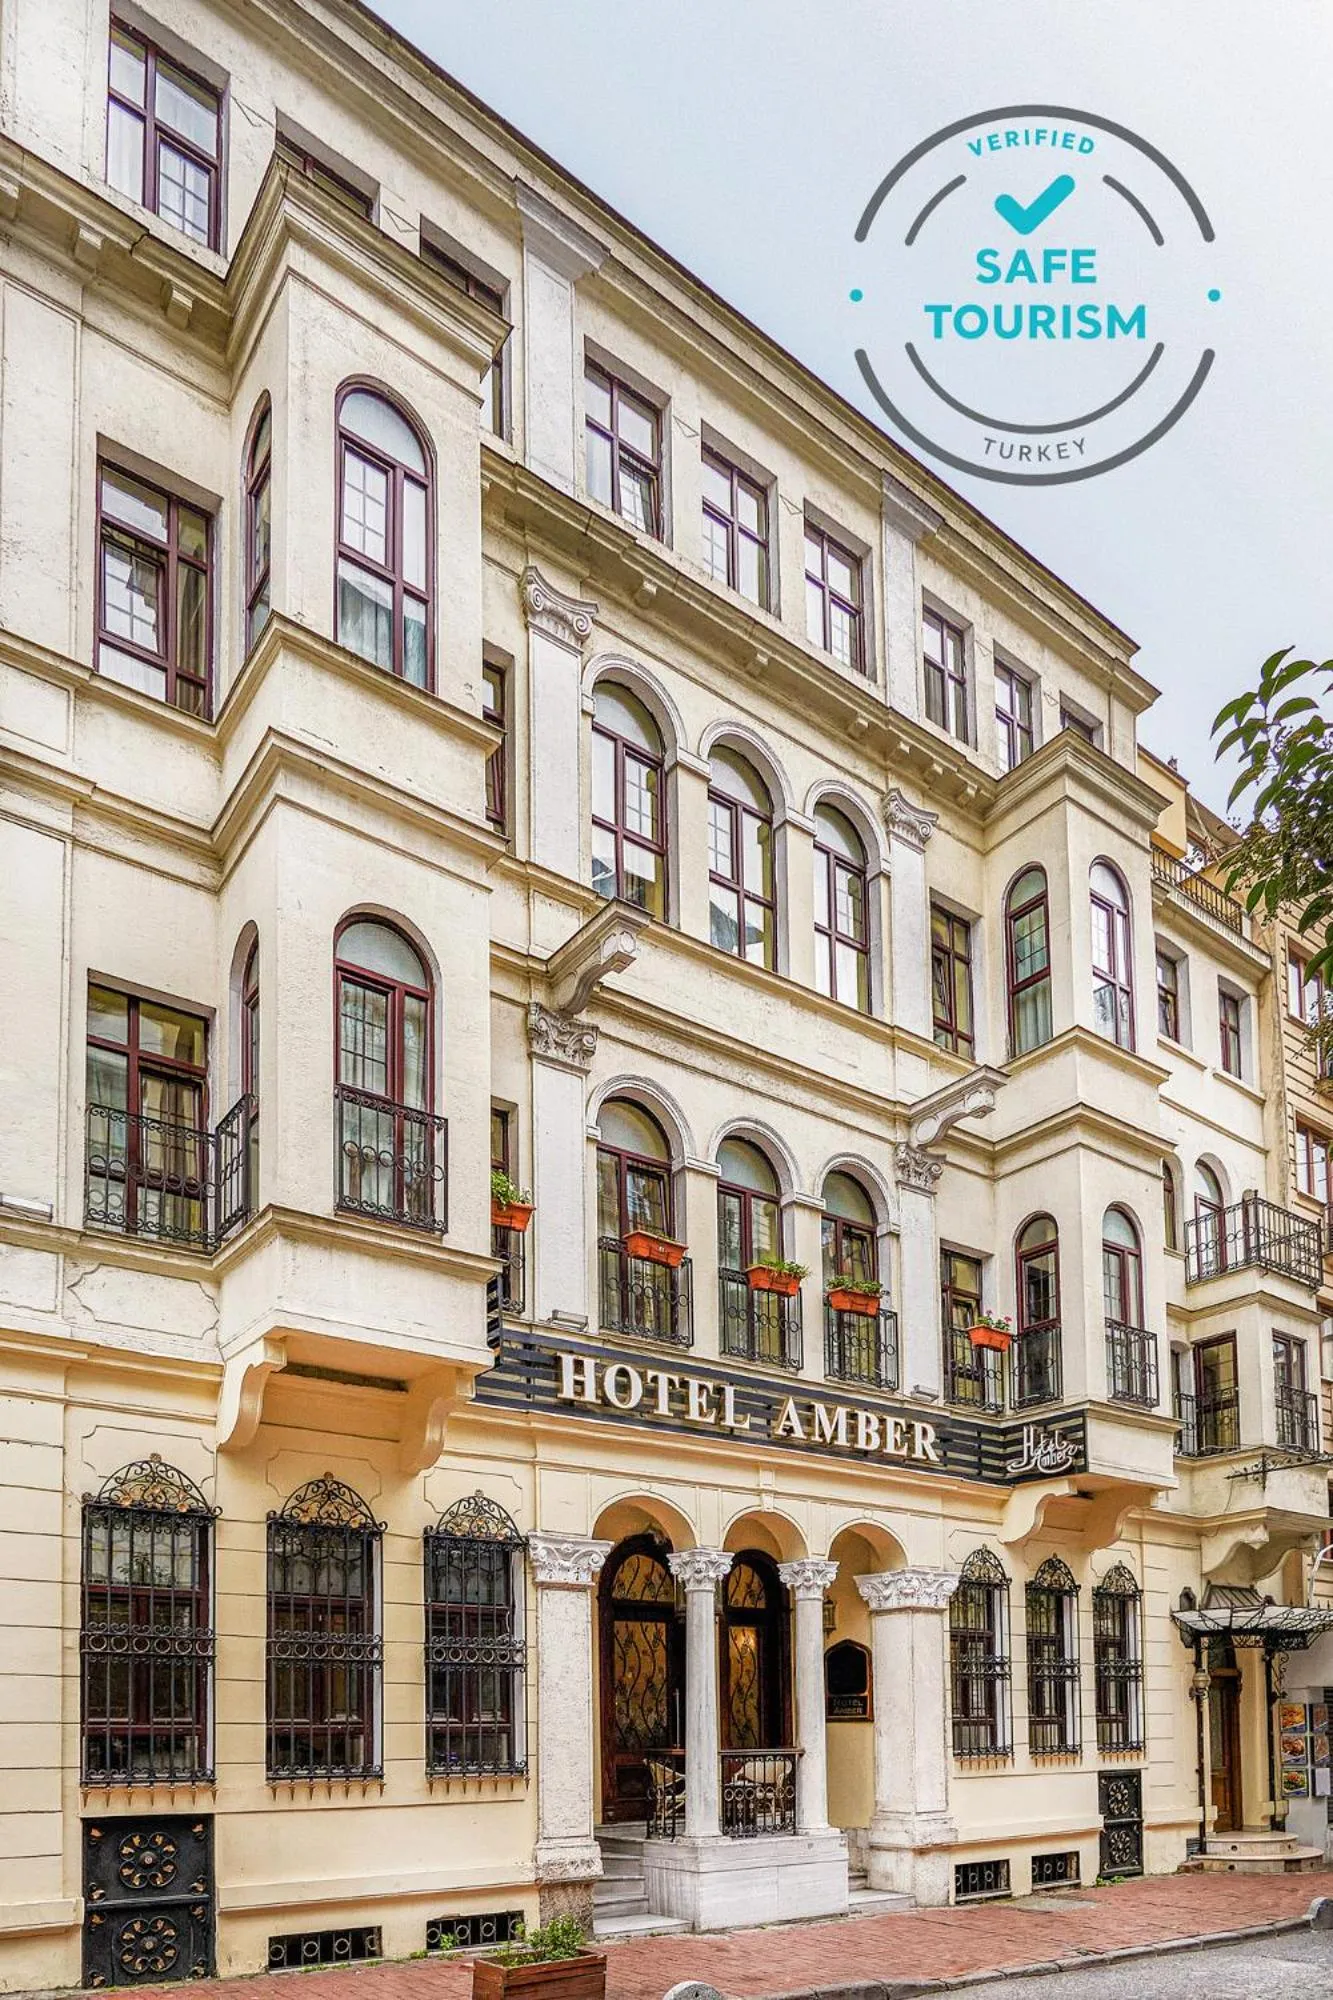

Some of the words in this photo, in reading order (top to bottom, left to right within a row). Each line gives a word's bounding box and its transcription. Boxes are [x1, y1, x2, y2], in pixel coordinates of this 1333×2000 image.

[556, 1352, 751, 1429] HOTEL
[775, 1396, 940, 1462] AMBER
[1011, 1424, 1068, 1468] Hotel
